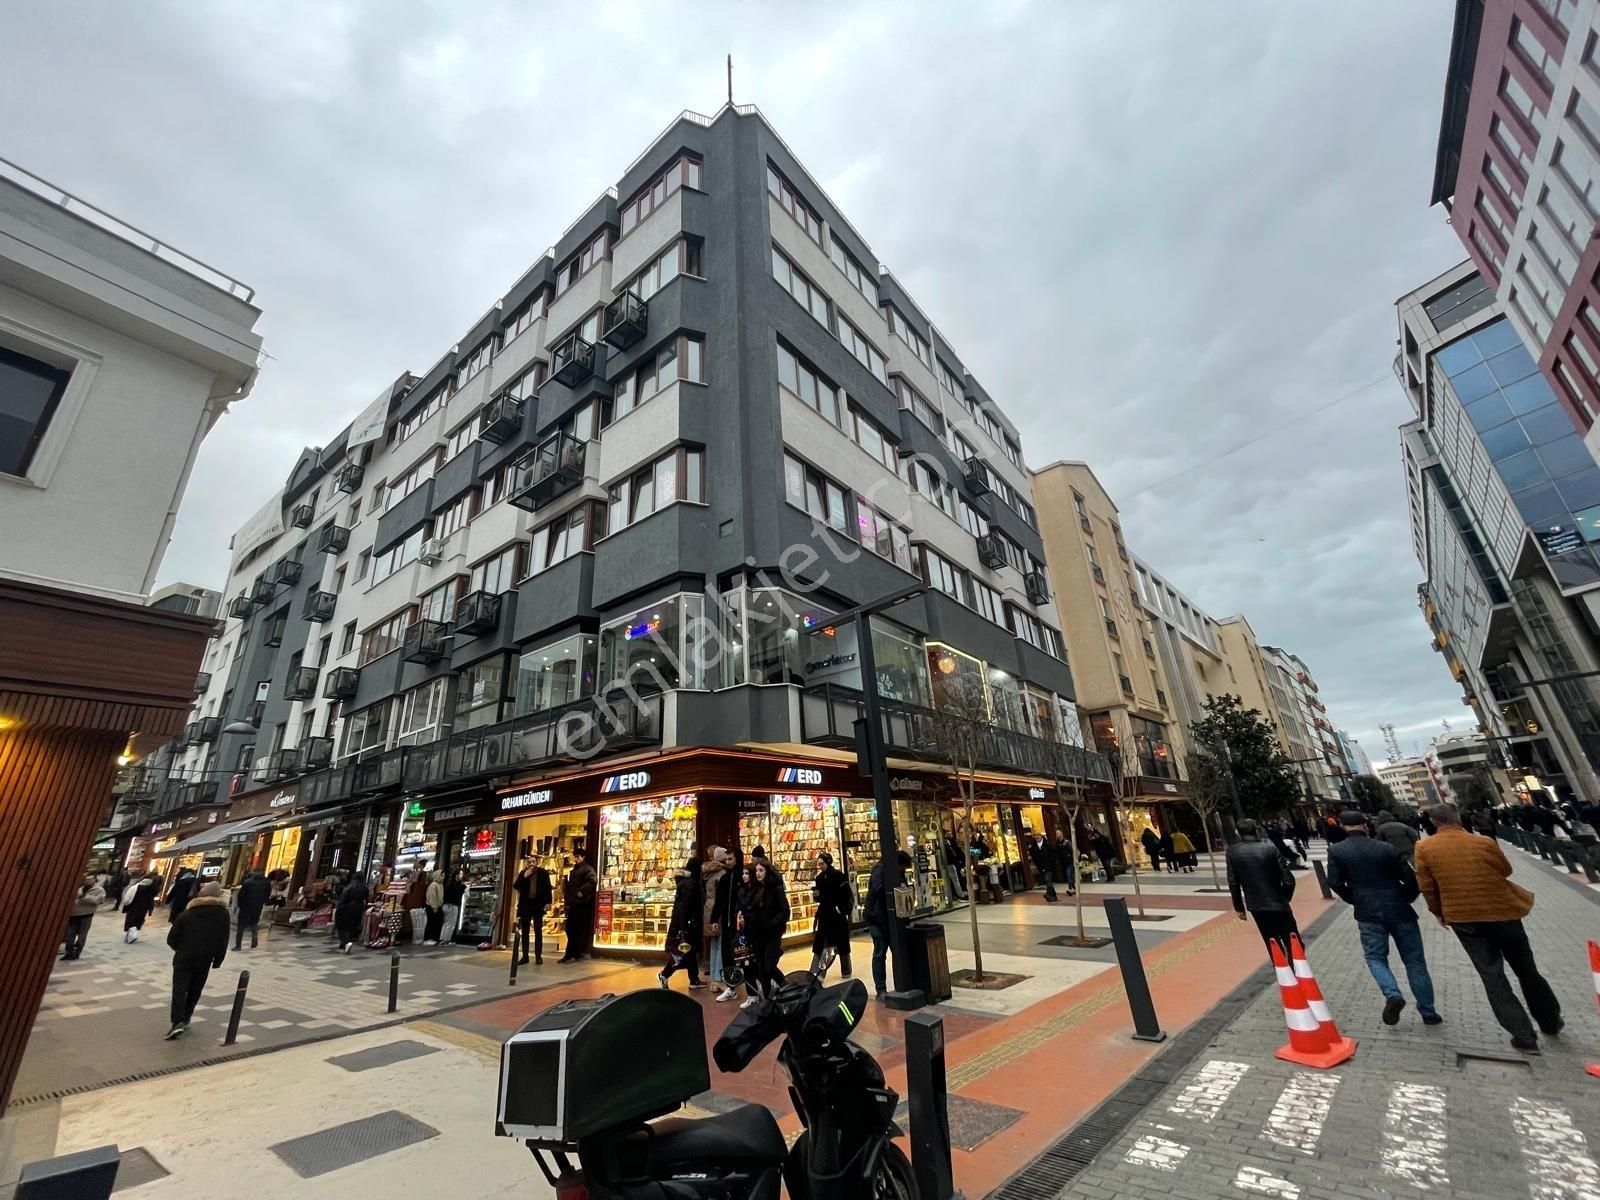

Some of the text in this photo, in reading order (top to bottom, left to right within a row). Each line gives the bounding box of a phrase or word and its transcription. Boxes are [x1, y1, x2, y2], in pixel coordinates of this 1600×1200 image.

[619, 771, 650, 791] ERD
[797, 768, 822, 785] ERD
[501, 795, 523, 810] ORHAN
